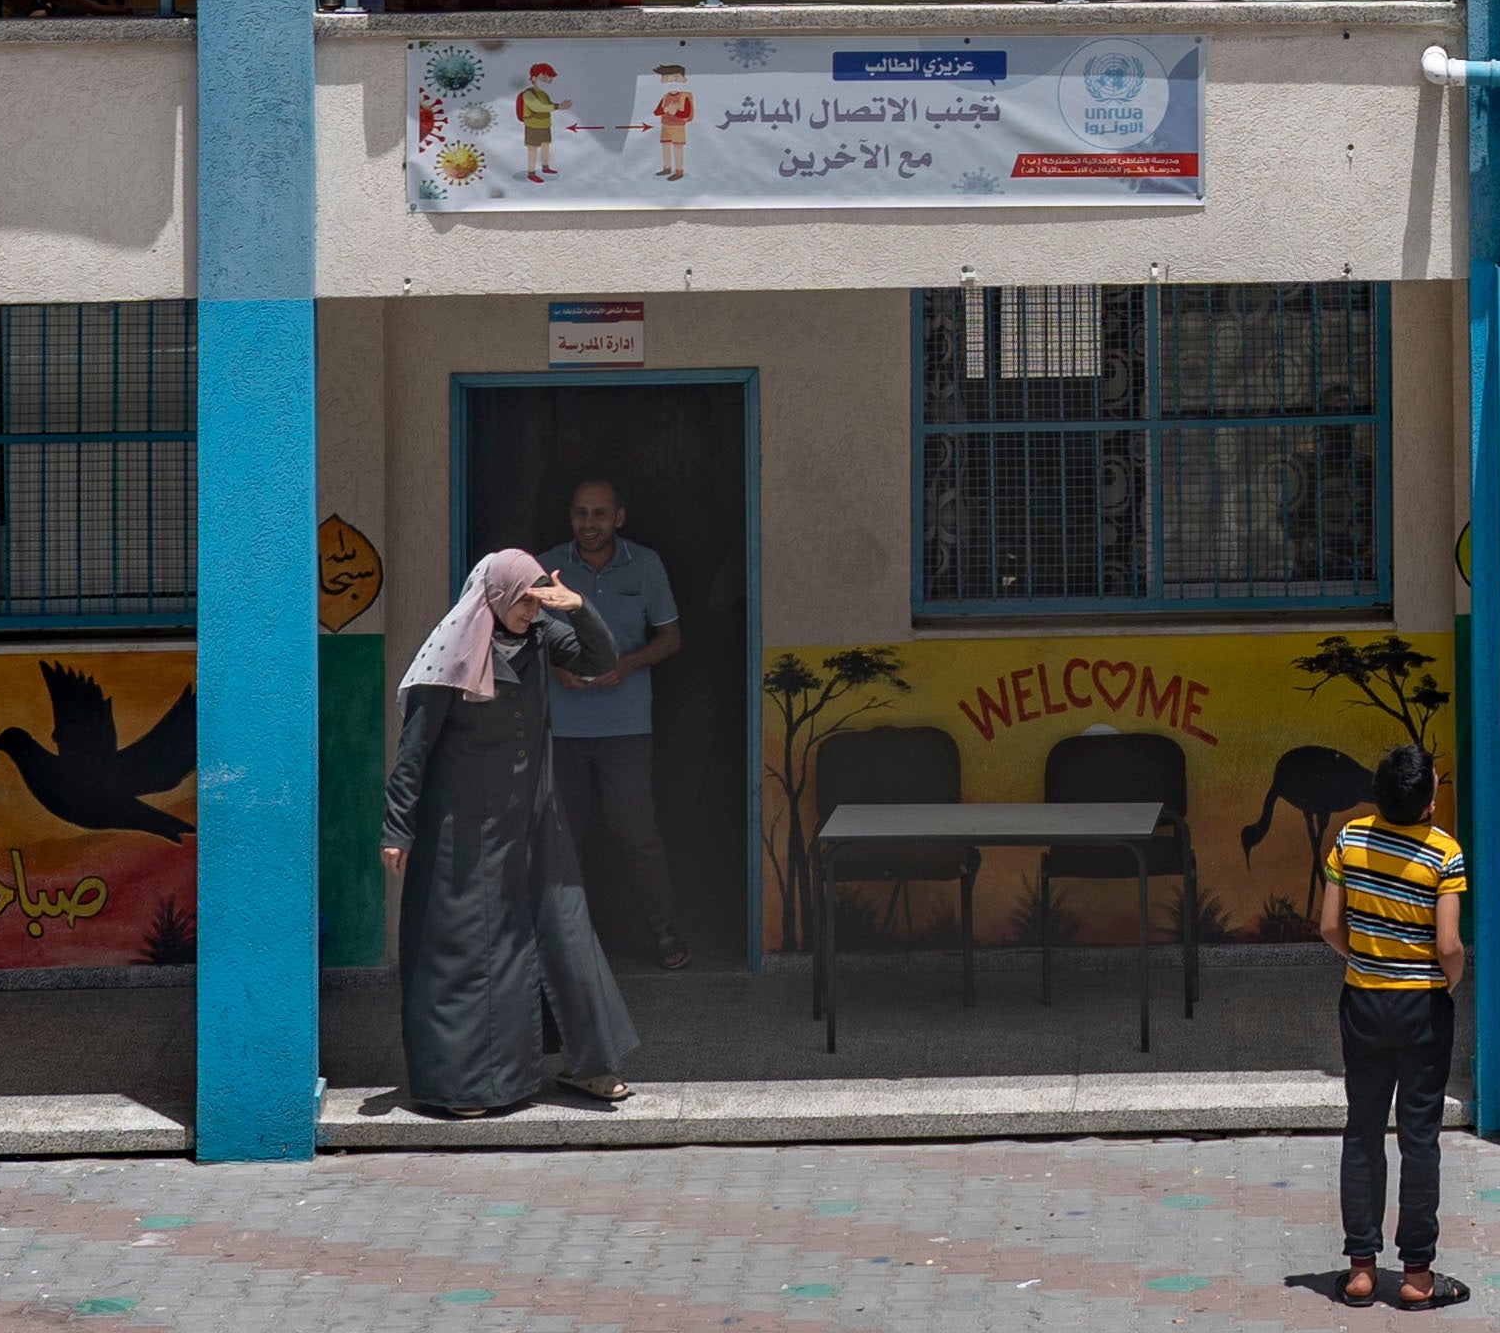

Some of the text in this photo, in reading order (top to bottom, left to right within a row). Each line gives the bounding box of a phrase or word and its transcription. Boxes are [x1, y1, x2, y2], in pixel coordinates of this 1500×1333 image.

[865, 56, 975, 78] عزيزي الطالب
[715, 95, 1001, 131] تجنب الاتصال المباشر
[1084, 107, 1143, 120] unrwa
[778, 139, 933, 178] مع الآخرين
[557, 334, 635, 353] إدارة المدرسة
